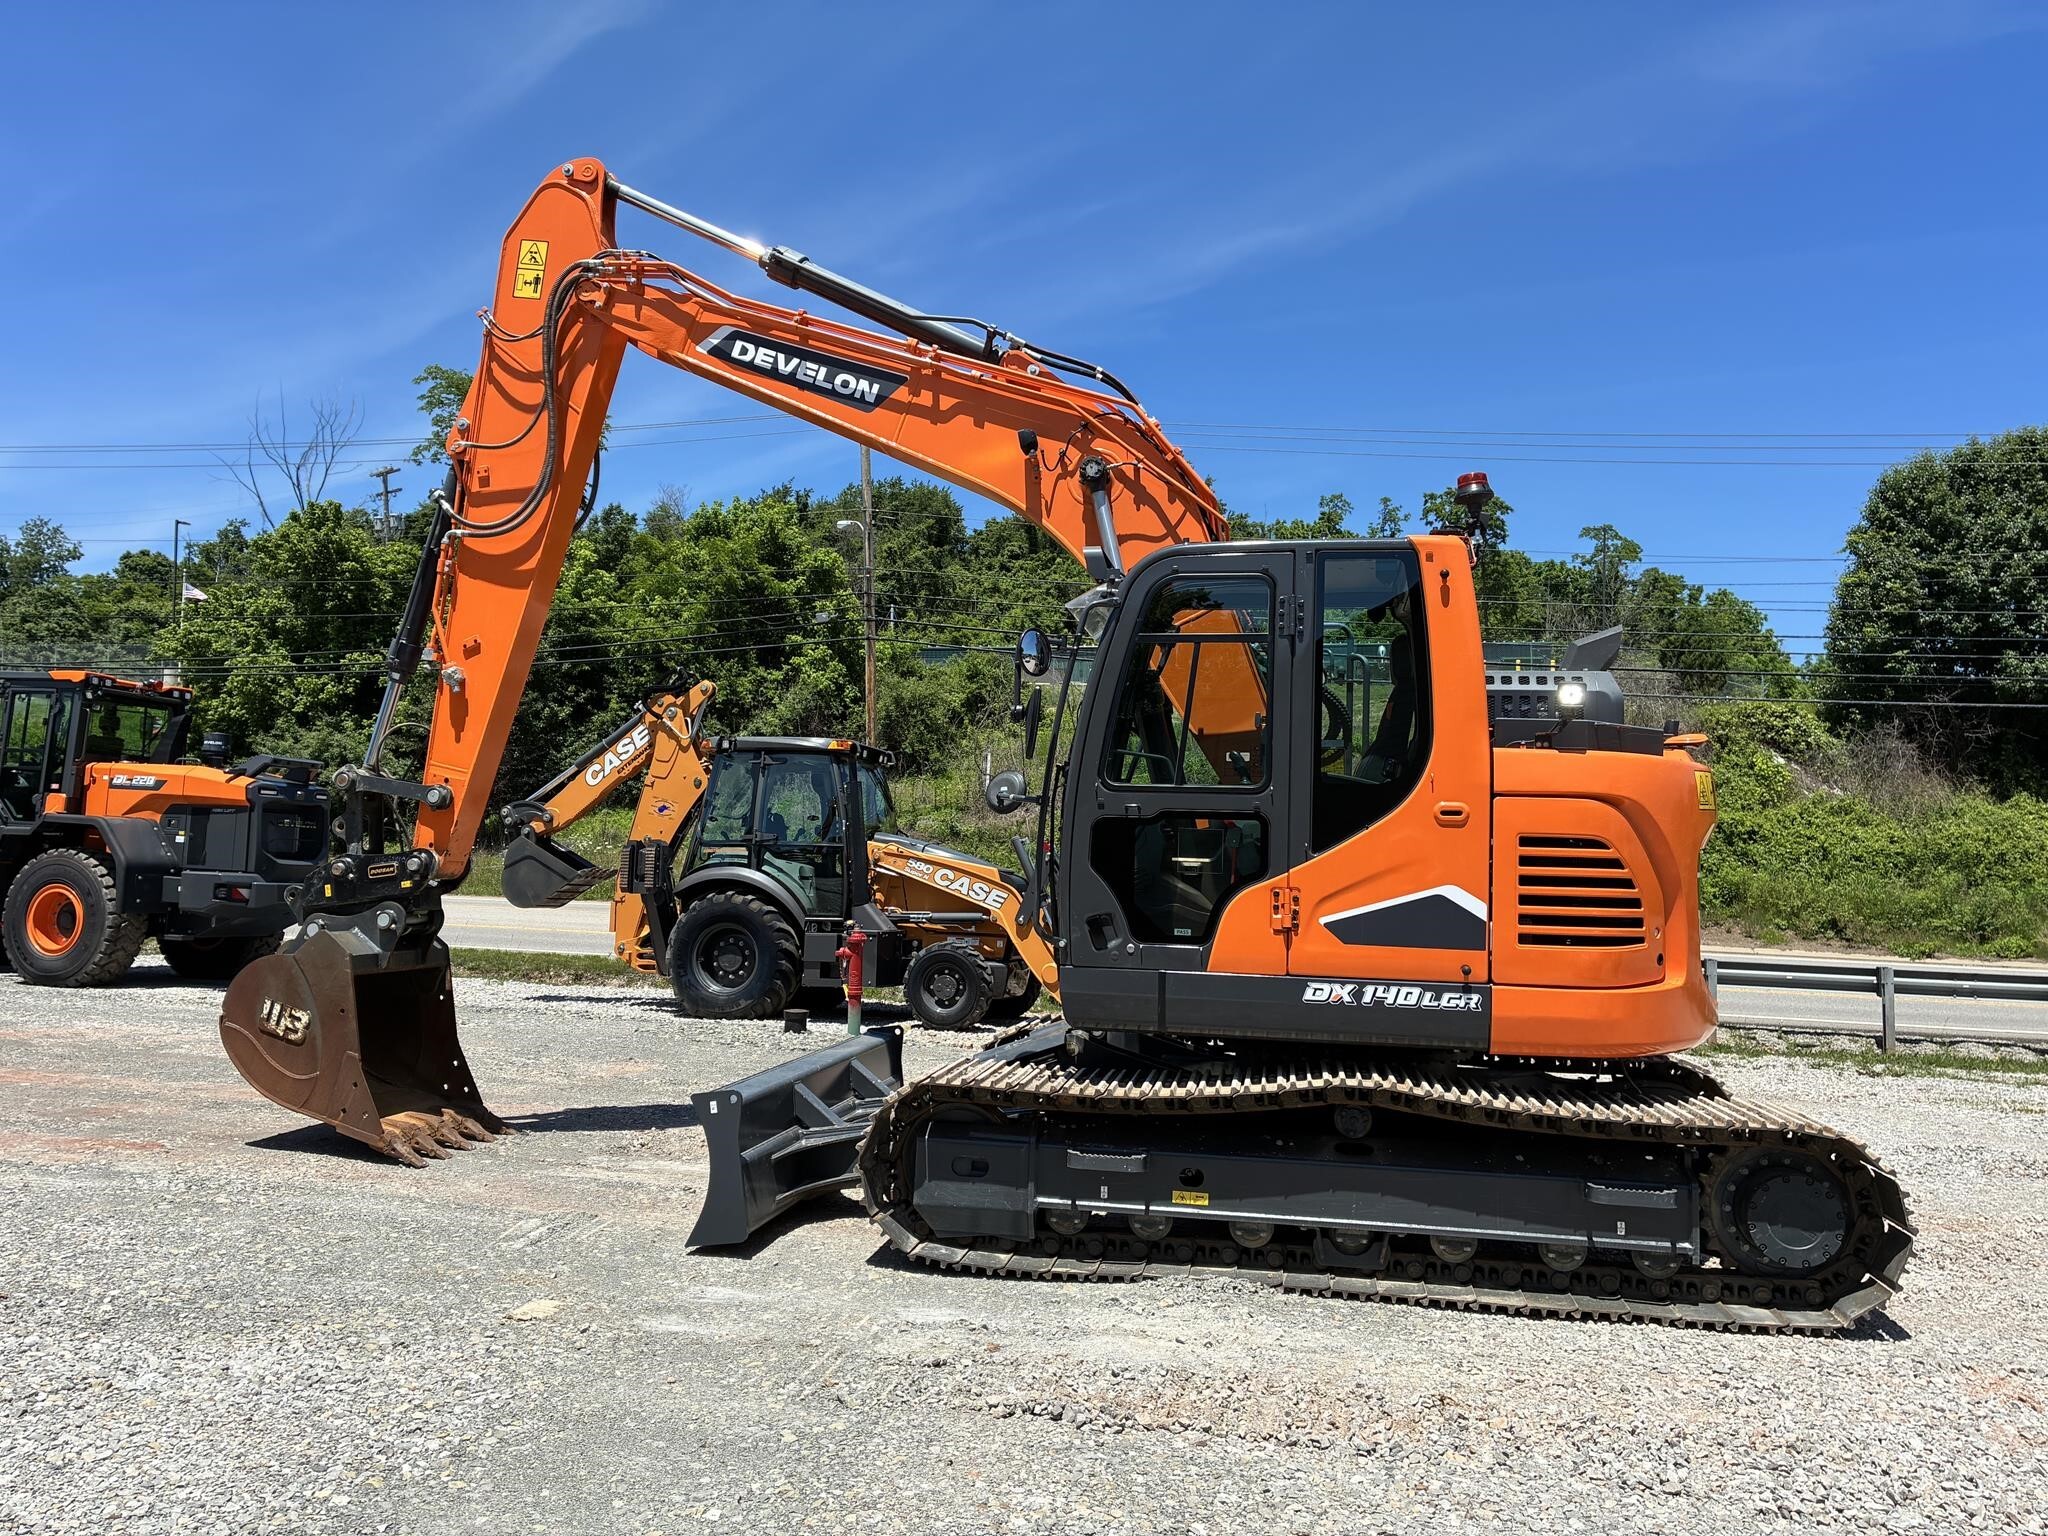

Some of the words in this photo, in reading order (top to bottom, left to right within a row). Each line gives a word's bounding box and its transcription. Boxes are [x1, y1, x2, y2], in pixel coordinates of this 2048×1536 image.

[731, 339, 880, 403] DEVELON
[585, 723, 651, 786] CASE
[906, 859, 933, 874] 580
[934, 868, 1009, 909] CASE
[1302, 982, 1358, 1005] DX
